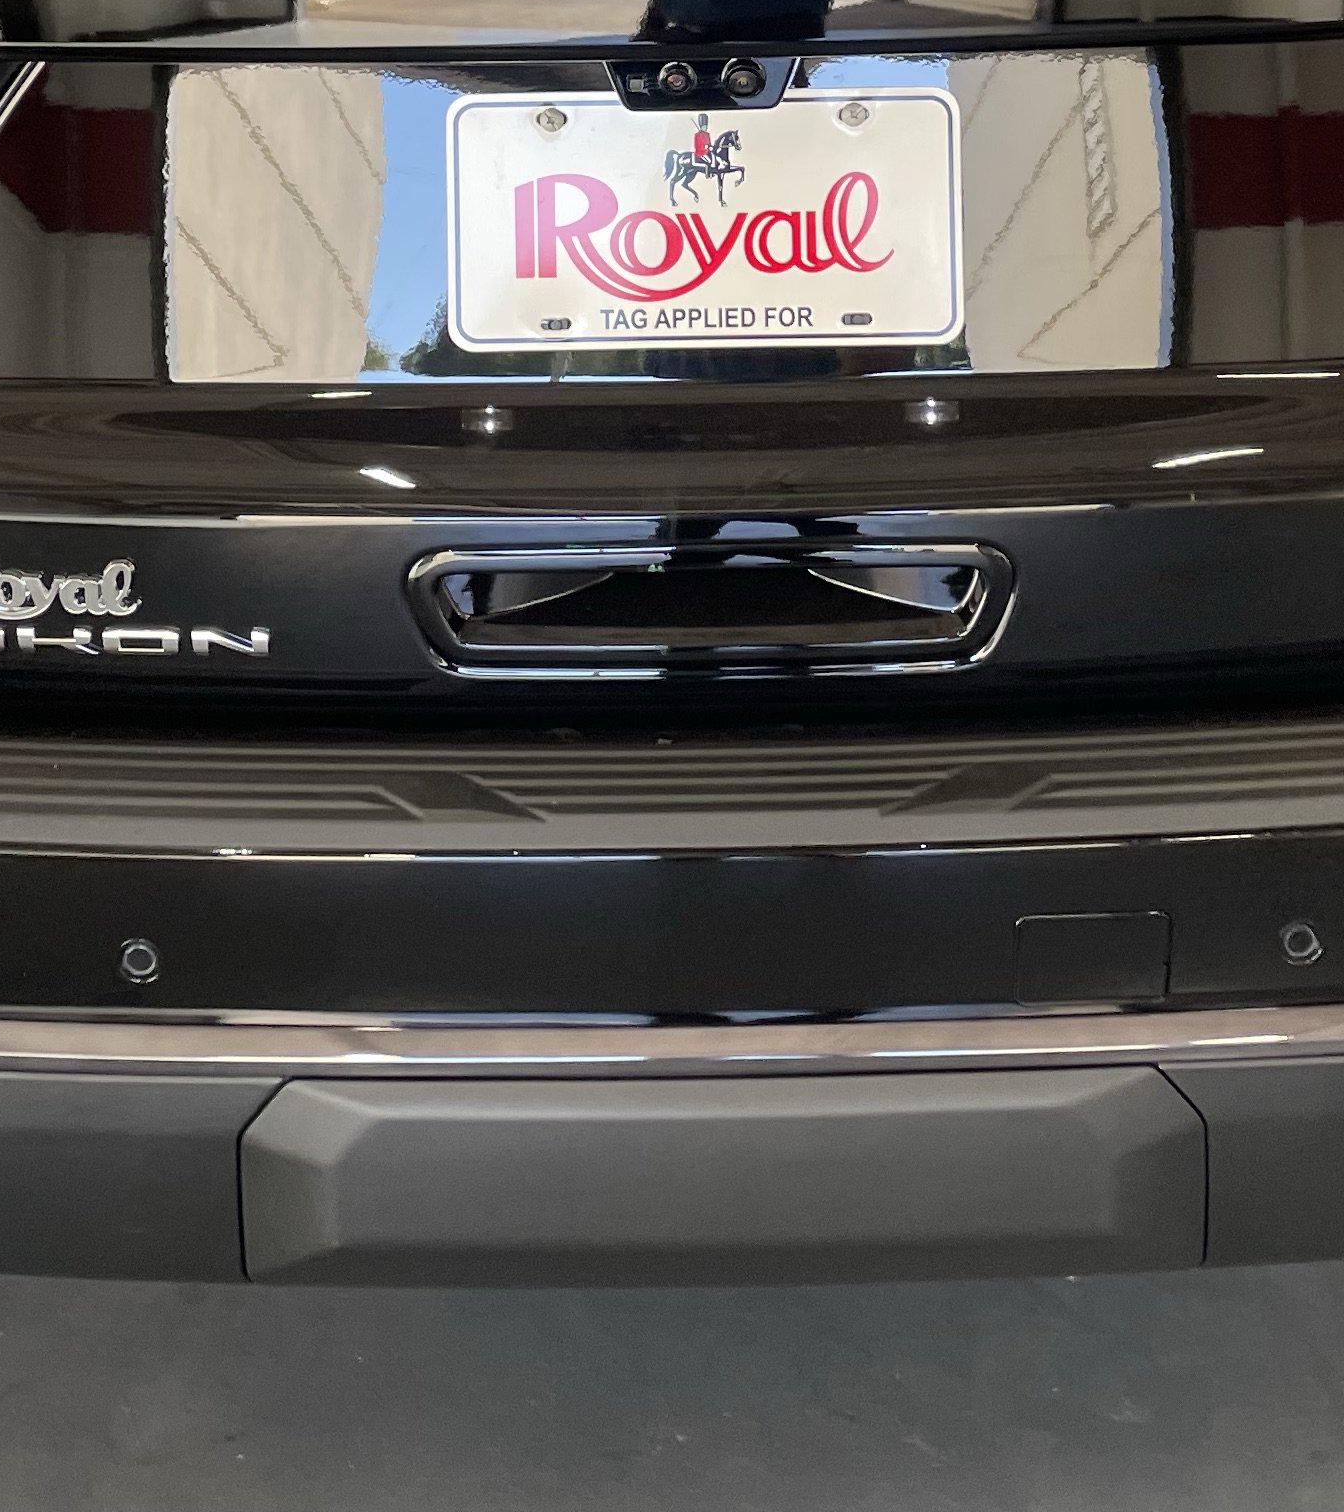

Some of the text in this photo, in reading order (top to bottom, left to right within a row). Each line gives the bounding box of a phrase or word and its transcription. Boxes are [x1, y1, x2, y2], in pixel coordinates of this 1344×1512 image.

[513, 170, 895, 303] Royal
[600, 306, 814, 330] TAG APPLIED FOR
